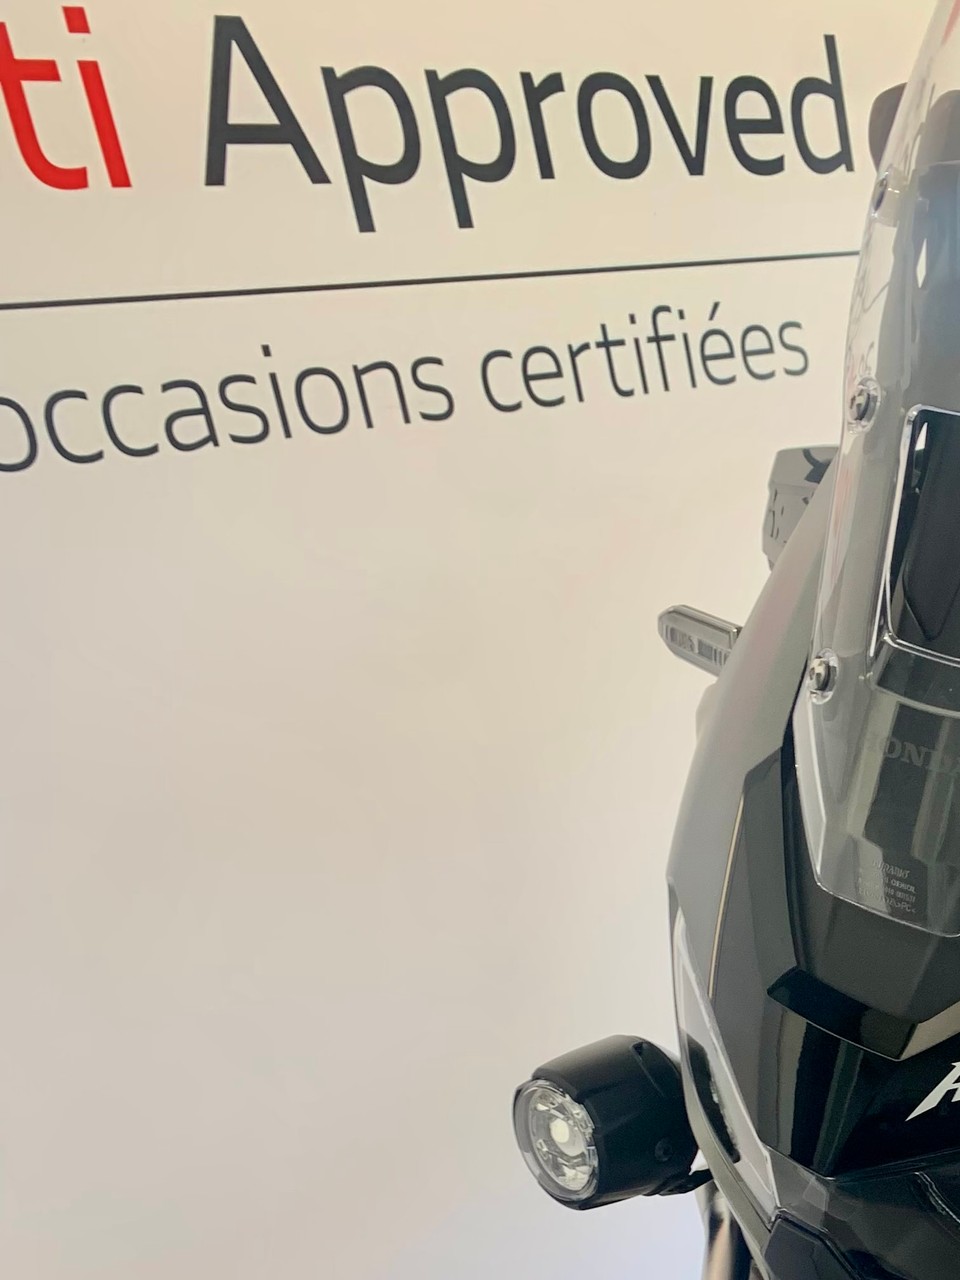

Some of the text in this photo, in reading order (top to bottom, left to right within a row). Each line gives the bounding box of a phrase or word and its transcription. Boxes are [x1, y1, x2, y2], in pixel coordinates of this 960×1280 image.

[204, 15, 854, 232] Approved
[0, 301, 809, 472] occasions certifiées
